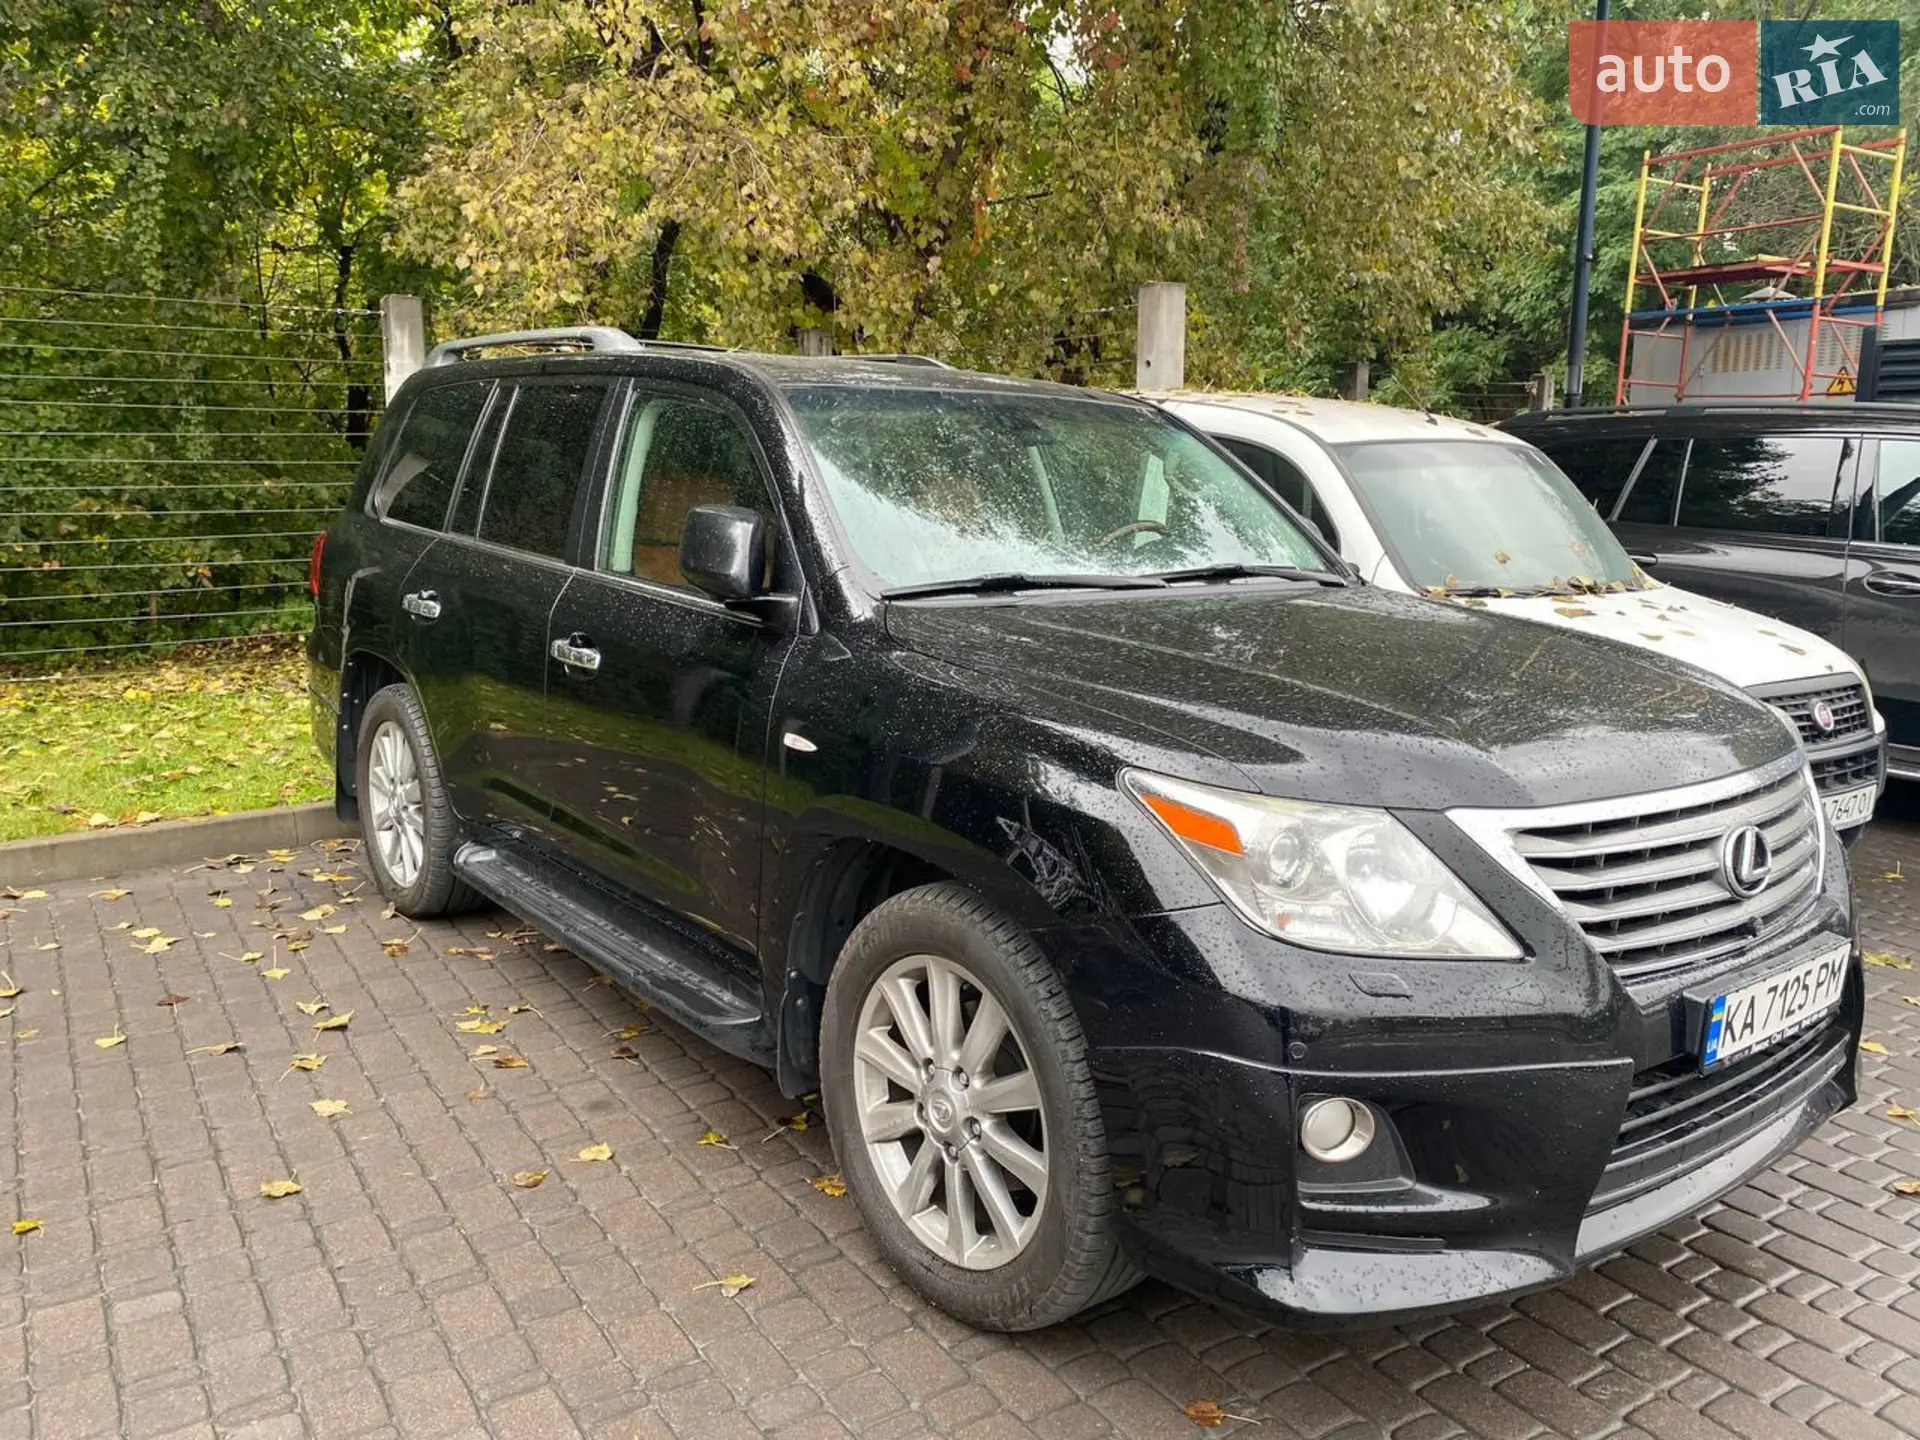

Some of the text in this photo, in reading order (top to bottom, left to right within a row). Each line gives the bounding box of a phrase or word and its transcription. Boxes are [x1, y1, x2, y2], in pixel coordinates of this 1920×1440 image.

[1829, 794, 1858, 820] 7647
[1721, 994, 1755, 1048] KA
[1761, 970, 1813, 1031] 7125
[1812, 953, 1846, 1005] PM
